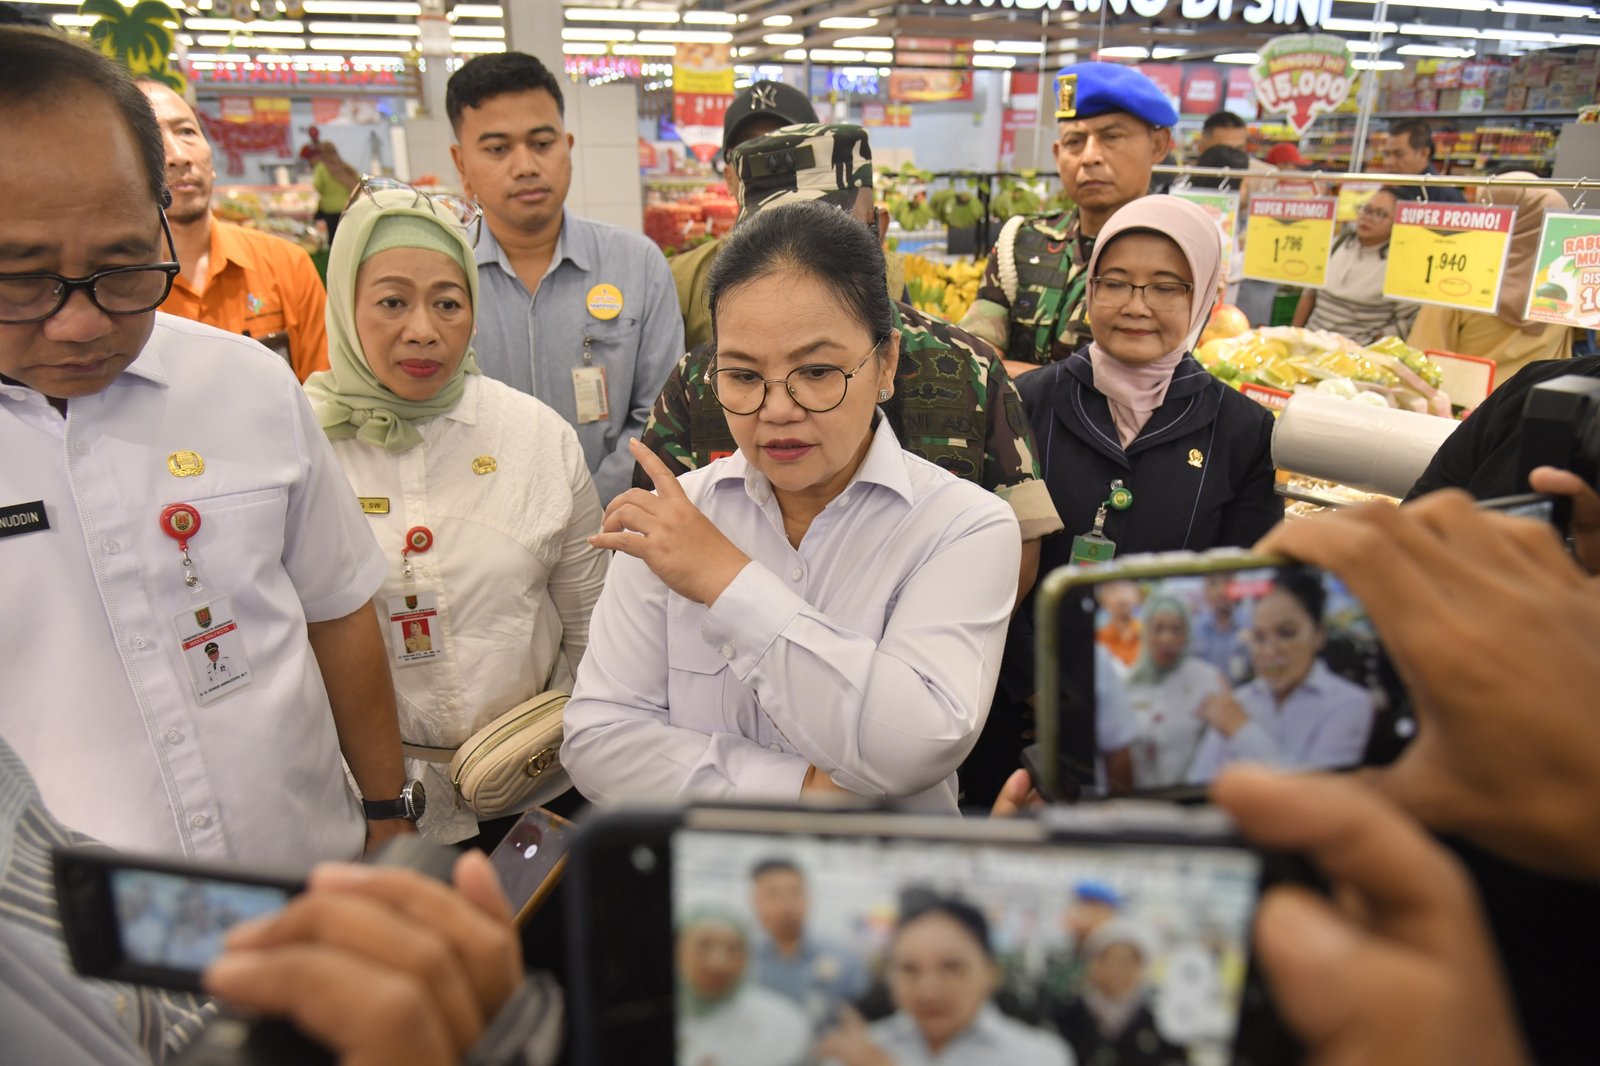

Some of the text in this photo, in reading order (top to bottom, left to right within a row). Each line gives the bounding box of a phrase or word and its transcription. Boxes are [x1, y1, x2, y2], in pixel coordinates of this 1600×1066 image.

[1254, 201, 1283, 216] SUPER
[1401, 207, 1501, 230] SUPER PROMO!
[0, 512, 39, 528] NUDDIN
